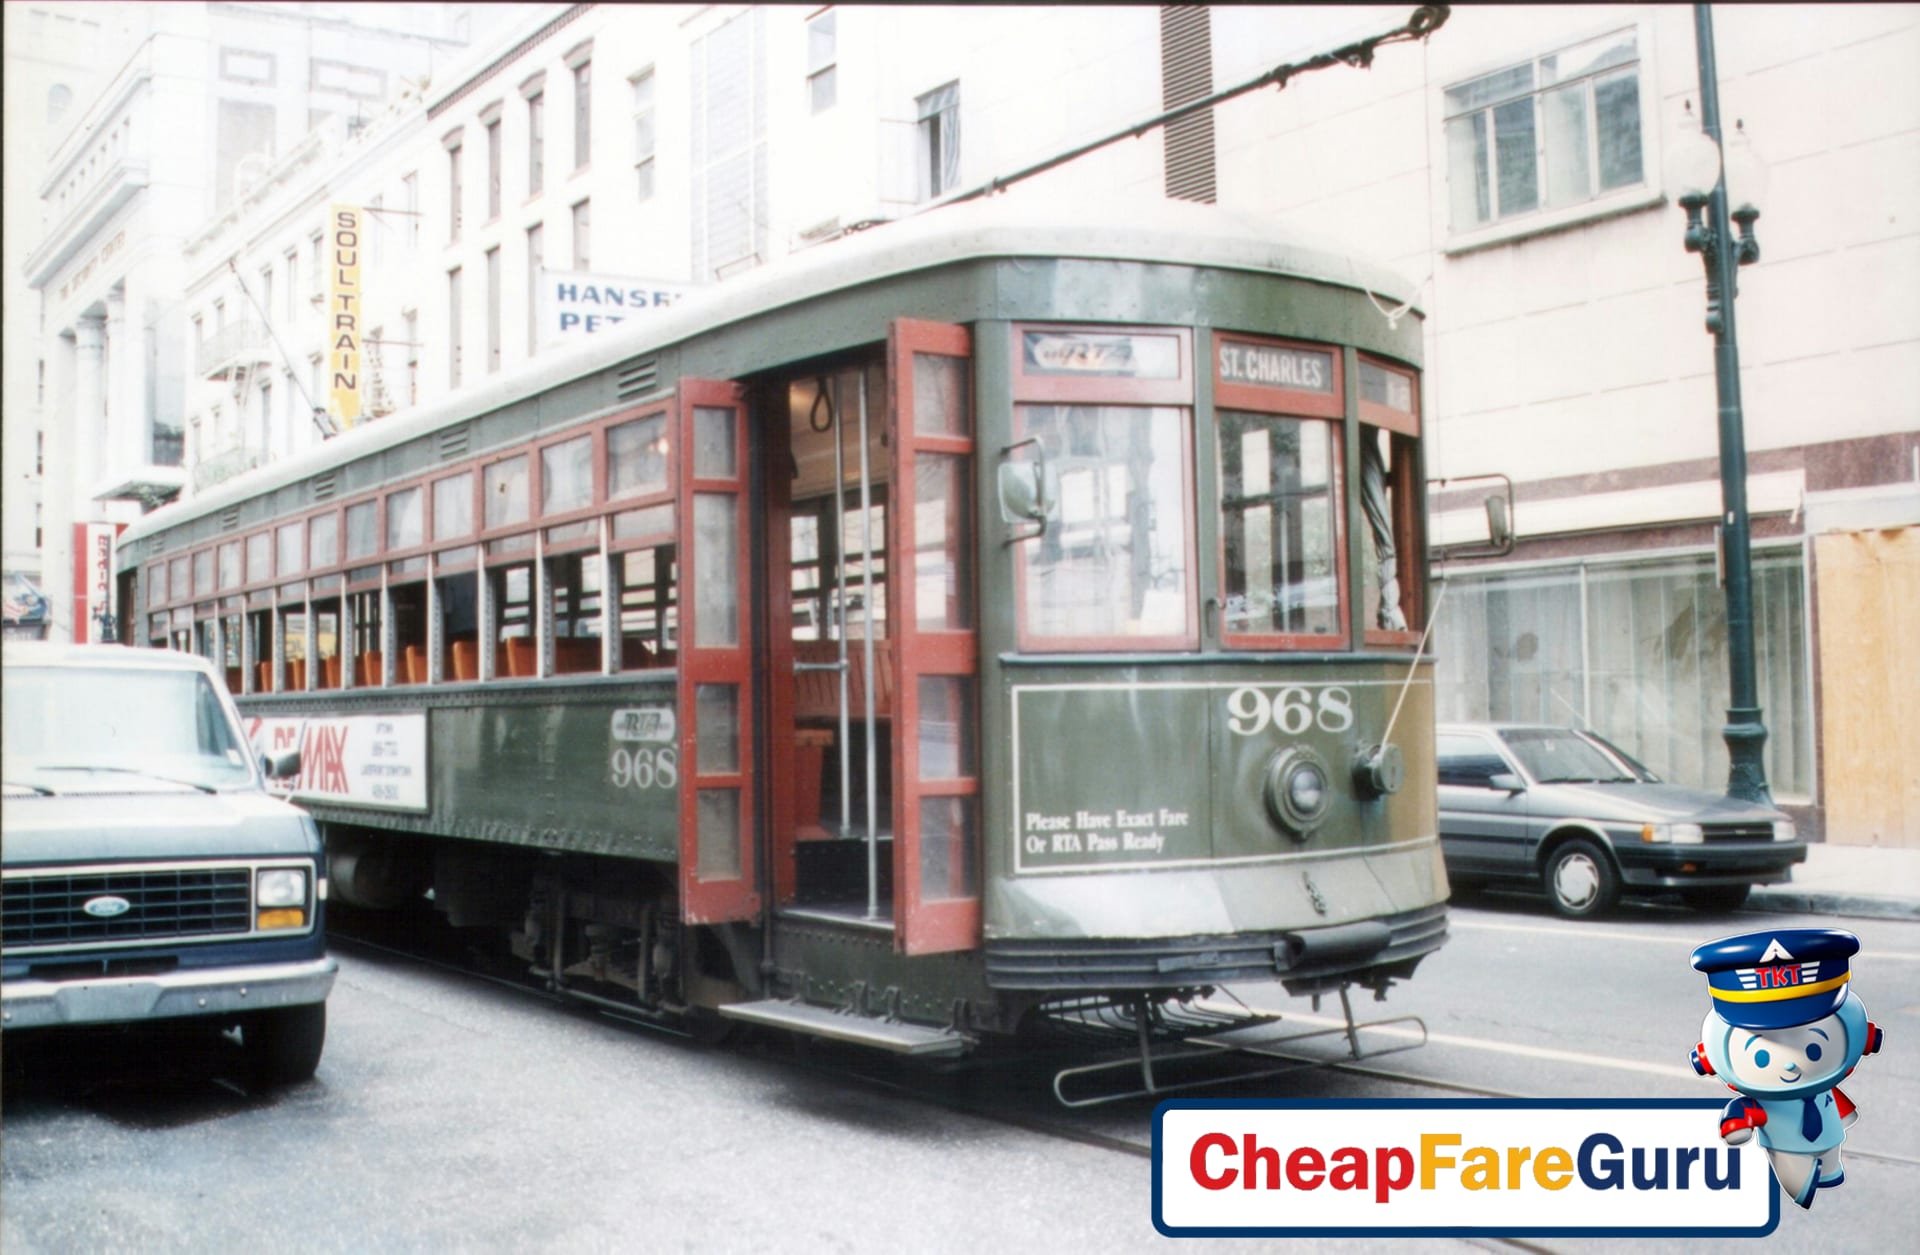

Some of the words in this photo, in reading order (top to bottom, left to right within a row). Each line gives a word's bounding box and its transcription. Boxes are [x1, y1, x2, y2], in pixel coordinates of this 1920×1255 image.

[336, 211, 358, 286] SOUL
[334, 294, 357, 390] TRAIN
[1219, 347, 1244, 378] ST.
[1245, 350, 1323, 388] CHARLES
[1227, 686, 1354, 737] 968
[611, 747, 678, 789] 968
[1025, 812, 1072, 832] Please
[1076, 806, 1113, 830] Have
[1116, 809, 1155, 829] Exact
[1159, 807, 1189, 827] Fare
[1025, 835, 1047, 853] Or
[1052, 833, 1082, 853] RTA
[1086, 832, 1119, 852] Pass
[1123, 830, 1165, 854] Ready
